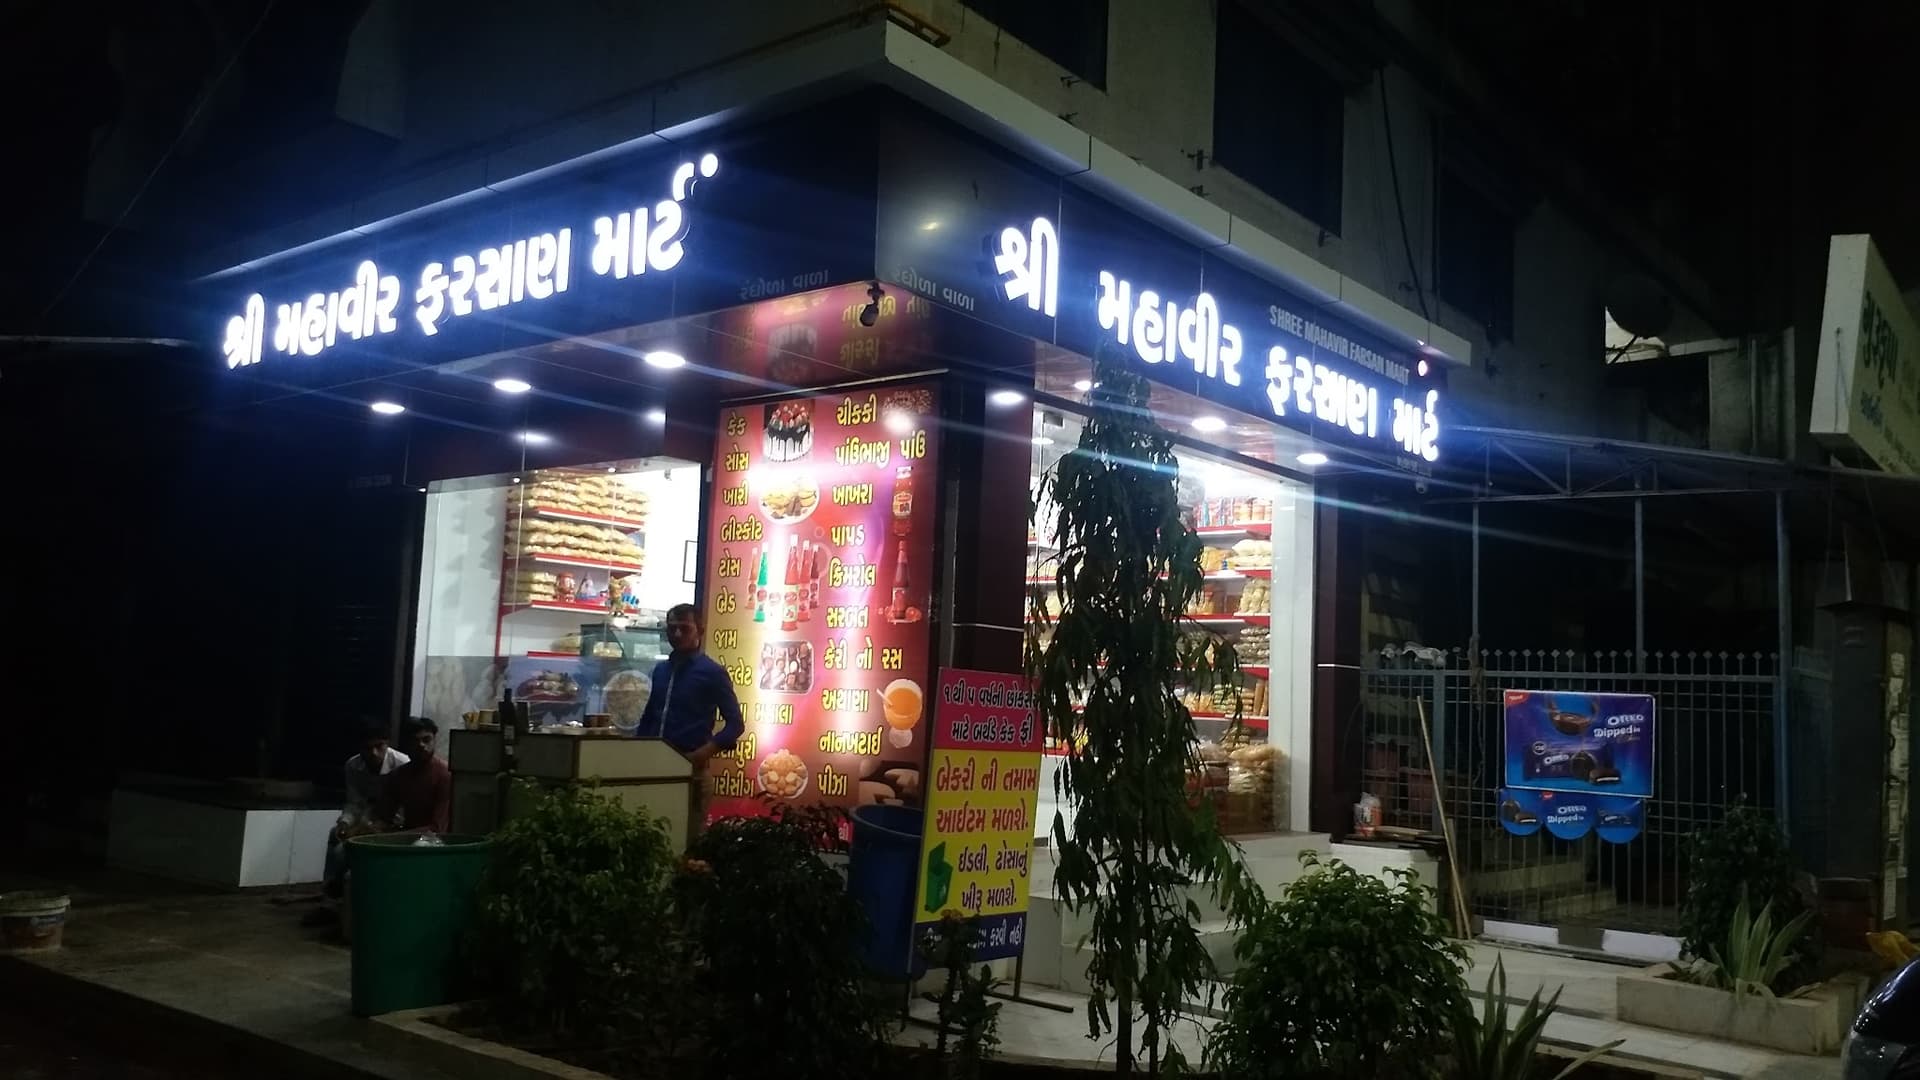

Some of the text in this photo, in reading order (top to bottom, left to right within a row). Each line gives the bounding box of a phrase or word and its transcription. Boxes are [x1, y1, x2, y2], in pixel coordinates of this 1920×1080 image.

[223, 153, 718, 369] શ્રી મહાવીર ફરસાણ માર્ટ
[943, 287, 974, 311] વાળા
[995, 217, 1439, 462] શ્રી મહાવીર ફરસાણ માર્ટ
[1270, 305, 1410, 386] SHREE MAHAVIR FARSAN MART
[727, 411, 746, 437] કેક
[836, 393, 877, 427] ચીકકી
[725, 444, 750, 472] સોસ
[723, 477, 749, 506] ખારી
[832, 483, 873, 505] ખાખરા
[720, 514, 763, 543] બીસ્કીટ
[831, 525, 865, 548] પાપડ
[718, 549, 741, 577] ટોસ
[716, 585, 736, 614] બ્રેડ
[826, 606, 869, 630] સરબત
[714, 629, 737, 649] જામ
[824, 636, 903, 670] કેરી નો રસ
[952, 714, 970, 741] માટે
[1000, 717, 1015, 743] કેક
[1594, 725, 1632, 739] Dipped
[1608, 713, 1644, 727] OREO
[817, 765, 848, 797] પીઝા
[936, 755, 1037, 791] બેકરી ની તમામ
[992, 797, 1029, 832] મળશે.
[1547, 813, 1578, 824] Dipped
[1558, 804, 1587, 815] OREO
[987, 879, 1017, 908] મળશે.
[990, 919, 1007, 947] કરવી
